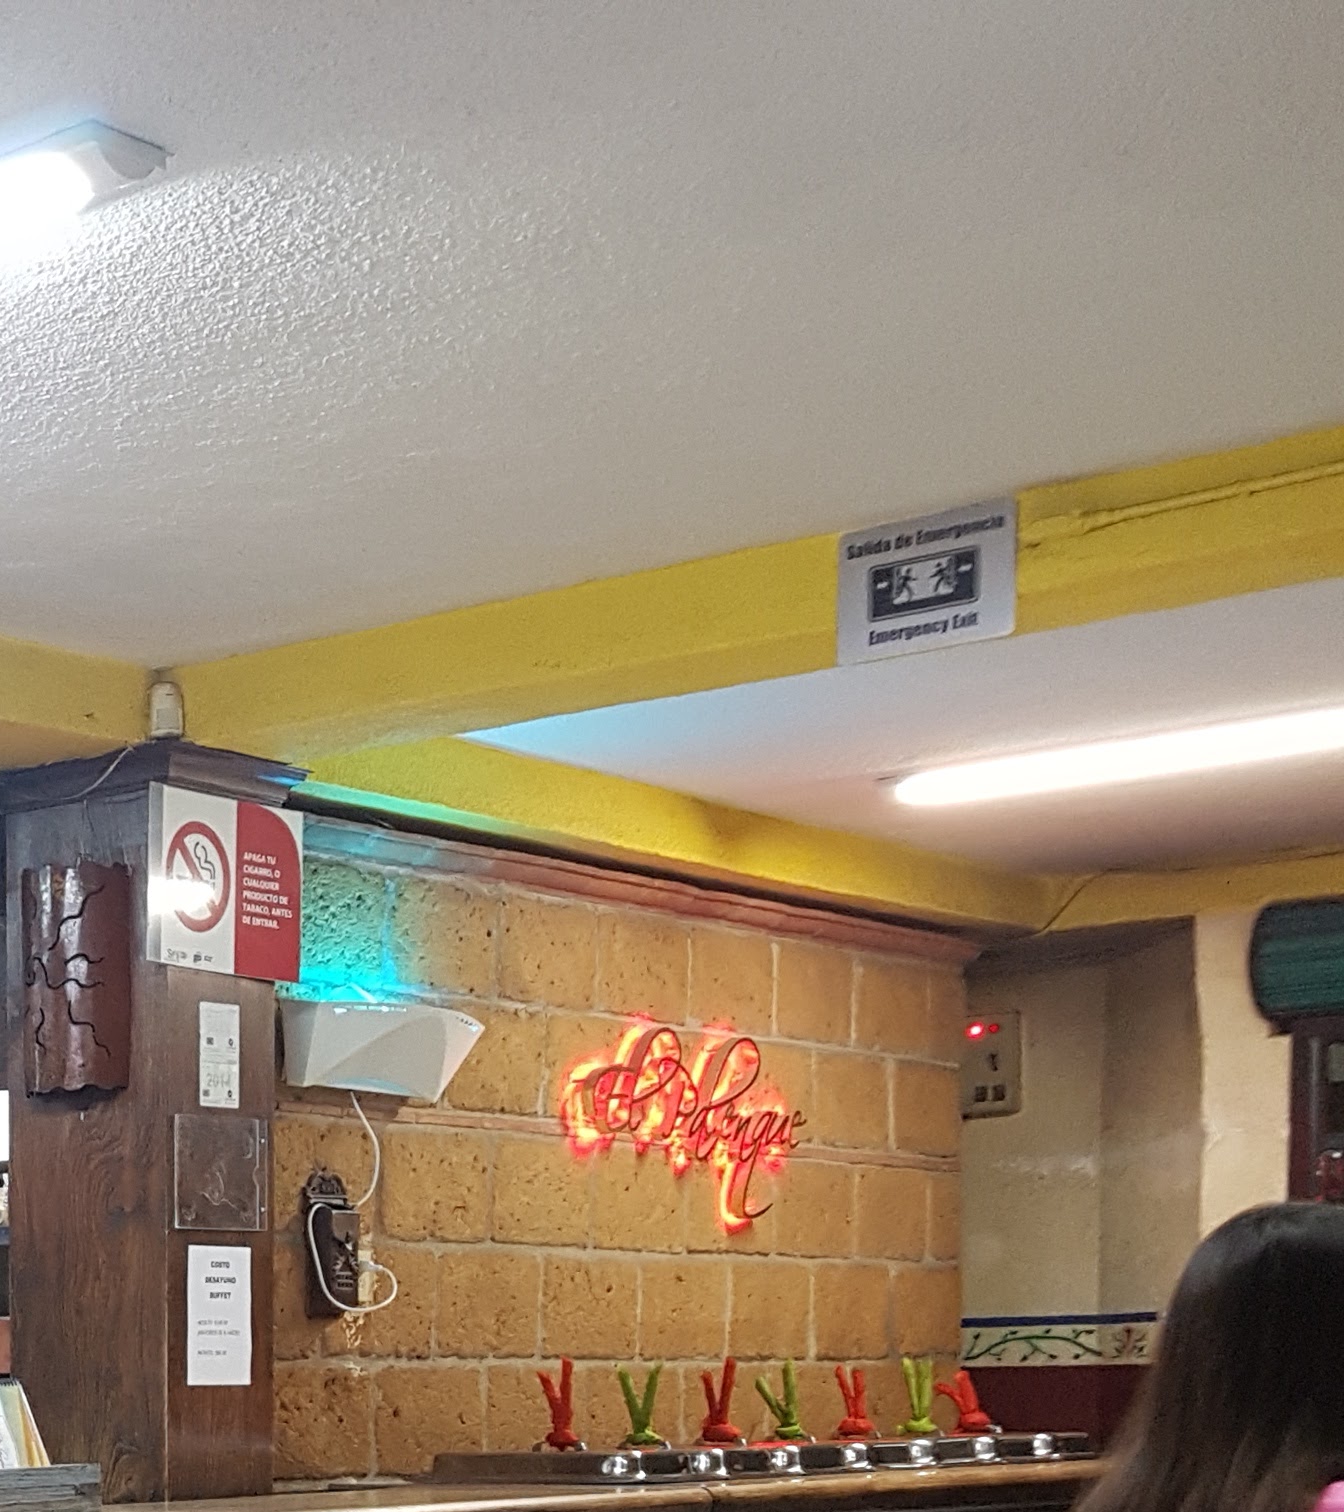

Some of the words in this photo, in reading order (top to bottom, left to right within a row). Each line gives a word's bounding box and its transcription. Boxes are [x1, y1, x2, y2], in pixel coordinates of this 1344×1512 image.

[847, 538, 892, 560] Salida
[916, 516, 1005, 545] Emergencia
[869, 620, 949, 646] Emergency
[953, 611, 978, 629] Exit
[266, 856, 277, 865] TU
[209, 1291, 232, 1299] BUFFET
